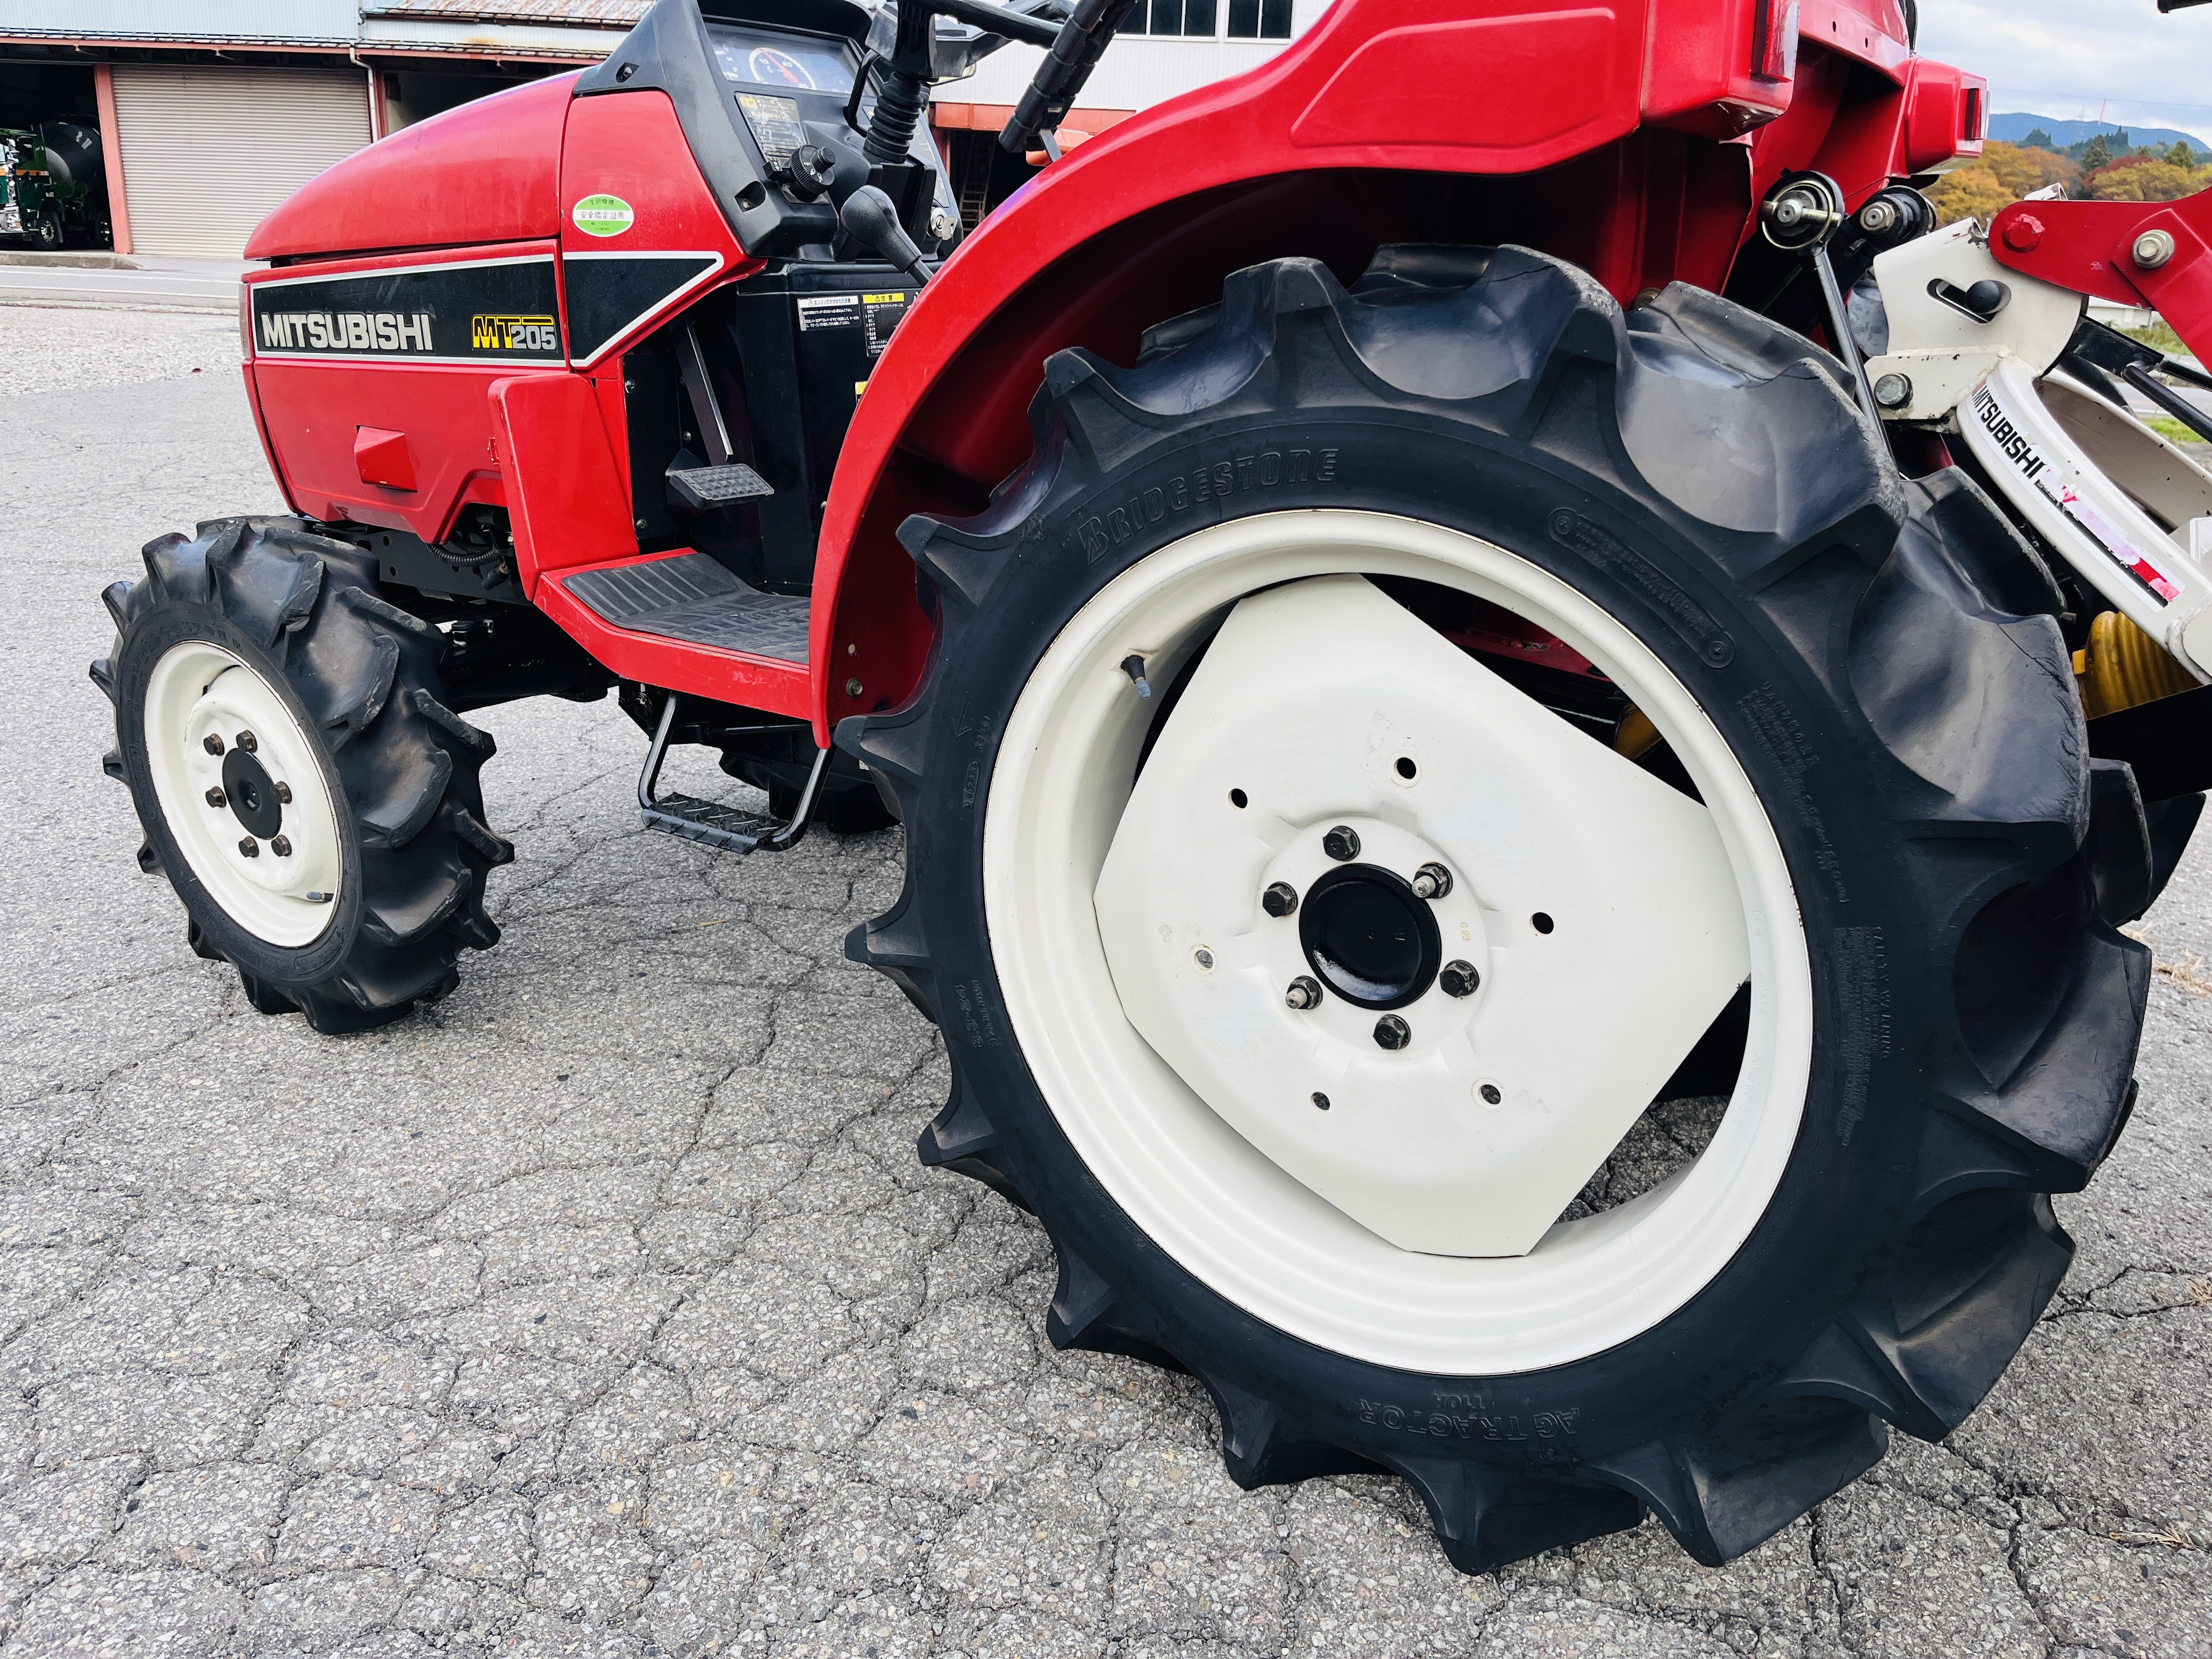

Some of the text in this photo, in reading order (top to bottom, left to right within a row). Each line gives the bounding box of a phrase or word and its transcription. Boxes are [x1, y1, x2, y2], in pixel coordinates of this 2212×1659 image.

[580, 211, 624, 219] 安全鑑定証票
[261, 313, 557, 351] MITSUBISHI MT205
[1972, 385, 2046, 480] MITSUBISHI
[1078, 448, 1339, 566] BRIDGESTONE
[1745, 1053, 1762, 1101] JAPAN
[1359, 1398, 1580, 1442] AG TRACTOR
